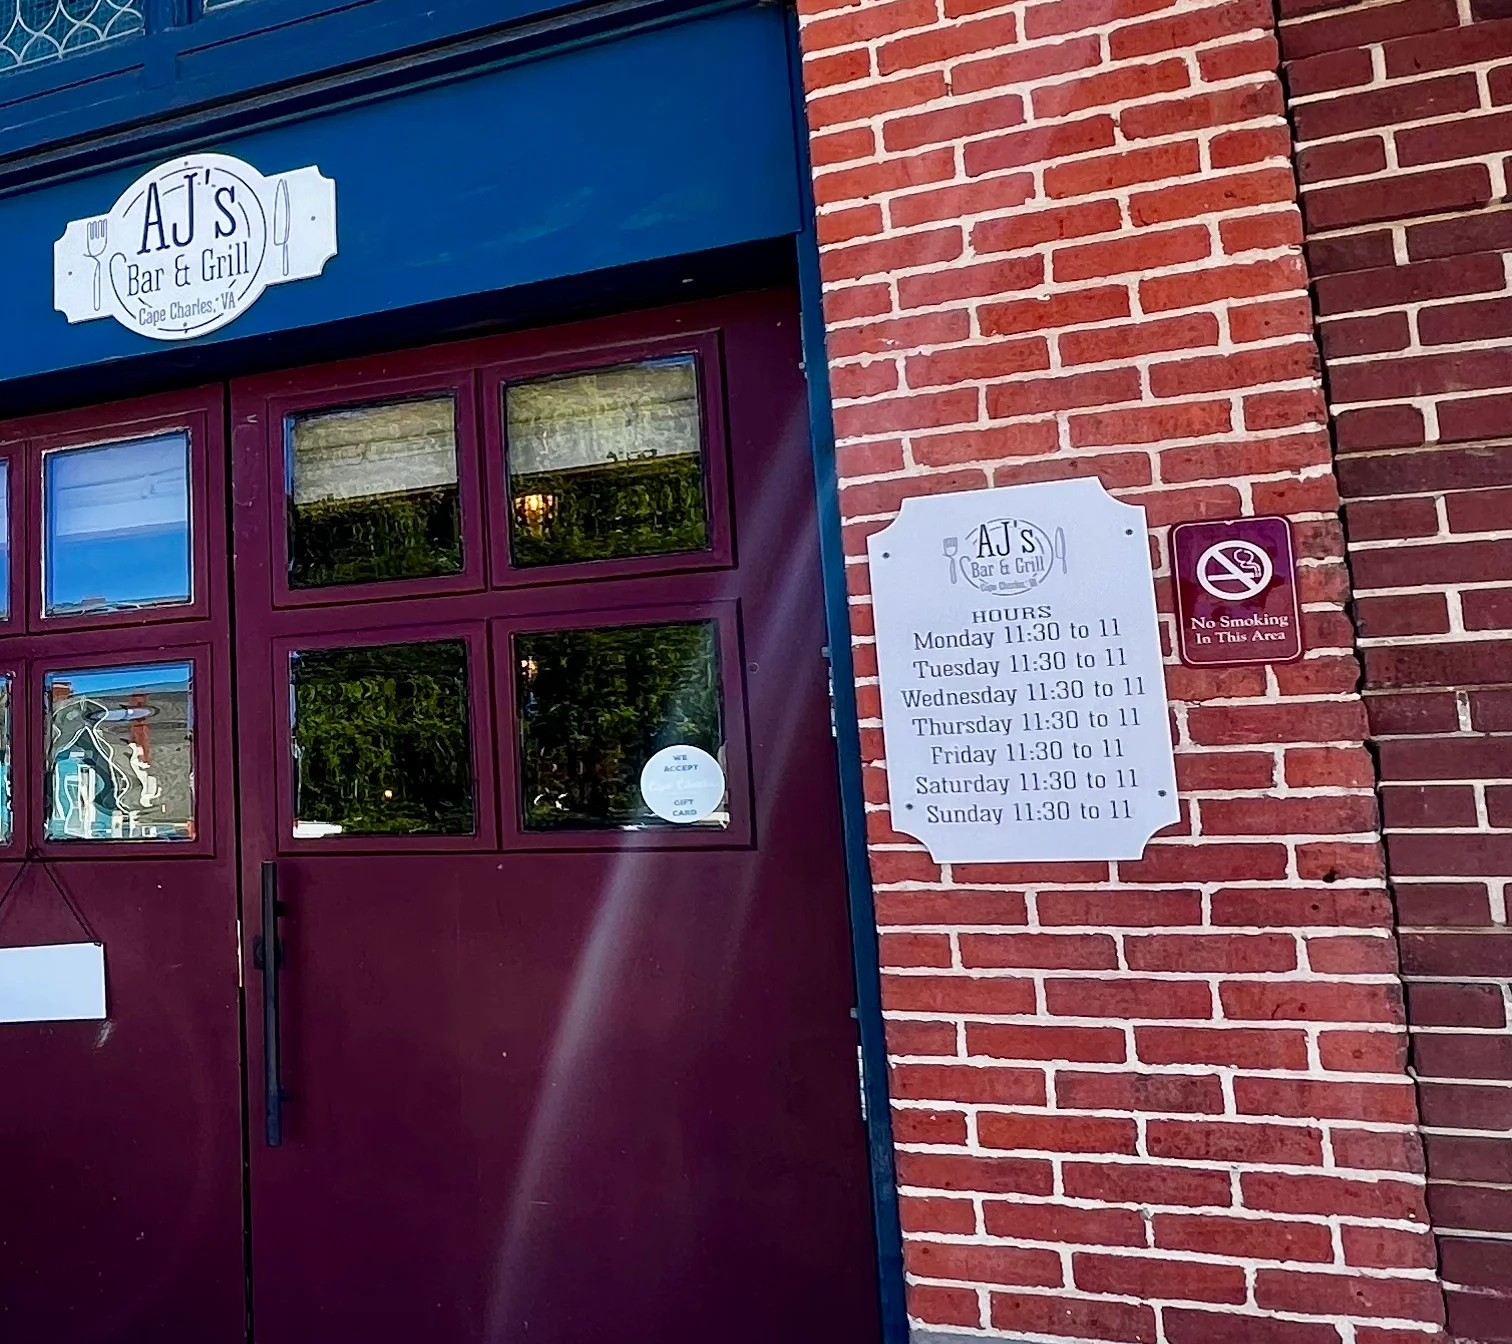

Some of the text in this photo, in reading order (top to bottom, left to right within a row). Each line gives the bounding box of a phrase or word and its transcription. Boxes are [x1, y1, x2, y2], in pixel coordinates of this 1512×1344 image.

[137, 168, 237, 254] AJ's
[127, 241, 249, 297] Bar & Grill
[138, 307, 166, 327] Cape
[221, 291, 236, 310] VA
[976, 520, 1035, 558] AJ's
[971, 555, 1044, 578] Bar & Grill
[972, 605, 1052, 623] HOURS
[1190, 613, 1289, 630] No Smoking
[913, 618, 1121, 651] Monday 11:30 to 11
[1196, 630, 1286, 645] In This Area
[913, 647, 1127, 678] Tuesday 11:30 to 11
[900, 676, 1146, 708] Wednesday 11:30 to 11
[911, 707, 1141, 736] Thursday 11:30 to 11
[931, 738, 1124, 766] Friday 11:30 to 11
[664, 764, 699, 772] ACCEPT
[915, 769, 1138, 795] Saturday 11:30 to 11
[926, 800, 1133, 825] Sunday 11:30 to 11
